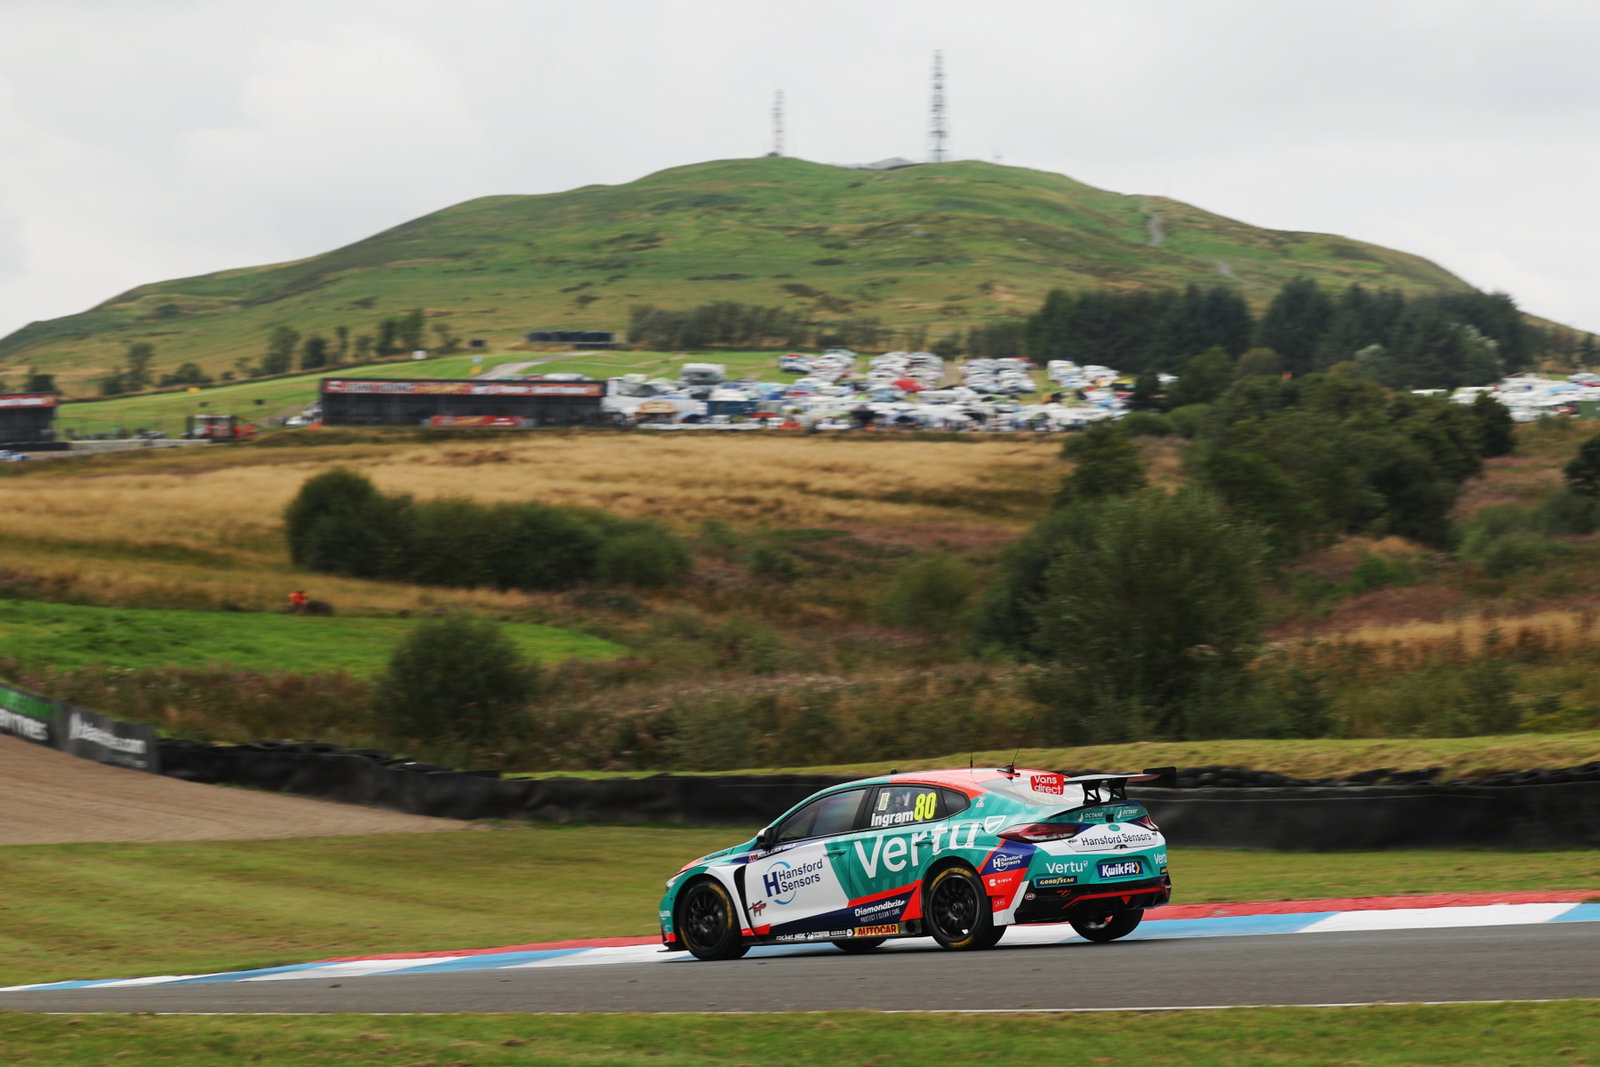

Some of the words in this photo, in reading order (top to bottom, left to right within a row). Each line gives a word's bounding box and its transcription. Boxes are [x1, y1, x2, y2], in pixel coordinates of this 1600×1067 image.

[1034, 775, 1057, 784] Vans
[1034, 783, 1062, 795] direct
[871, 810, 914, 827] Ingram
[914, 792, 937, 821] 80
[1080, 835, 1120, 846] Hansford
[1121, 833, 1152, 843] Sensors
[853, 823, 980, 879] Vertu
[1000, 854, 1023, 862] Hansford
[1000, 859, 1021, 867] Sensors
[778, 858, 823, 881] Hansford
[1045, 862, 1083, 874] Vertu
[780, 873, 821, 892] Sensors
[1040, 877, 1075, 885] GOODYEAR
[854, 899, 906, 917] Diamondbrite
[857, 924, 897, 936] AUTOCAR
